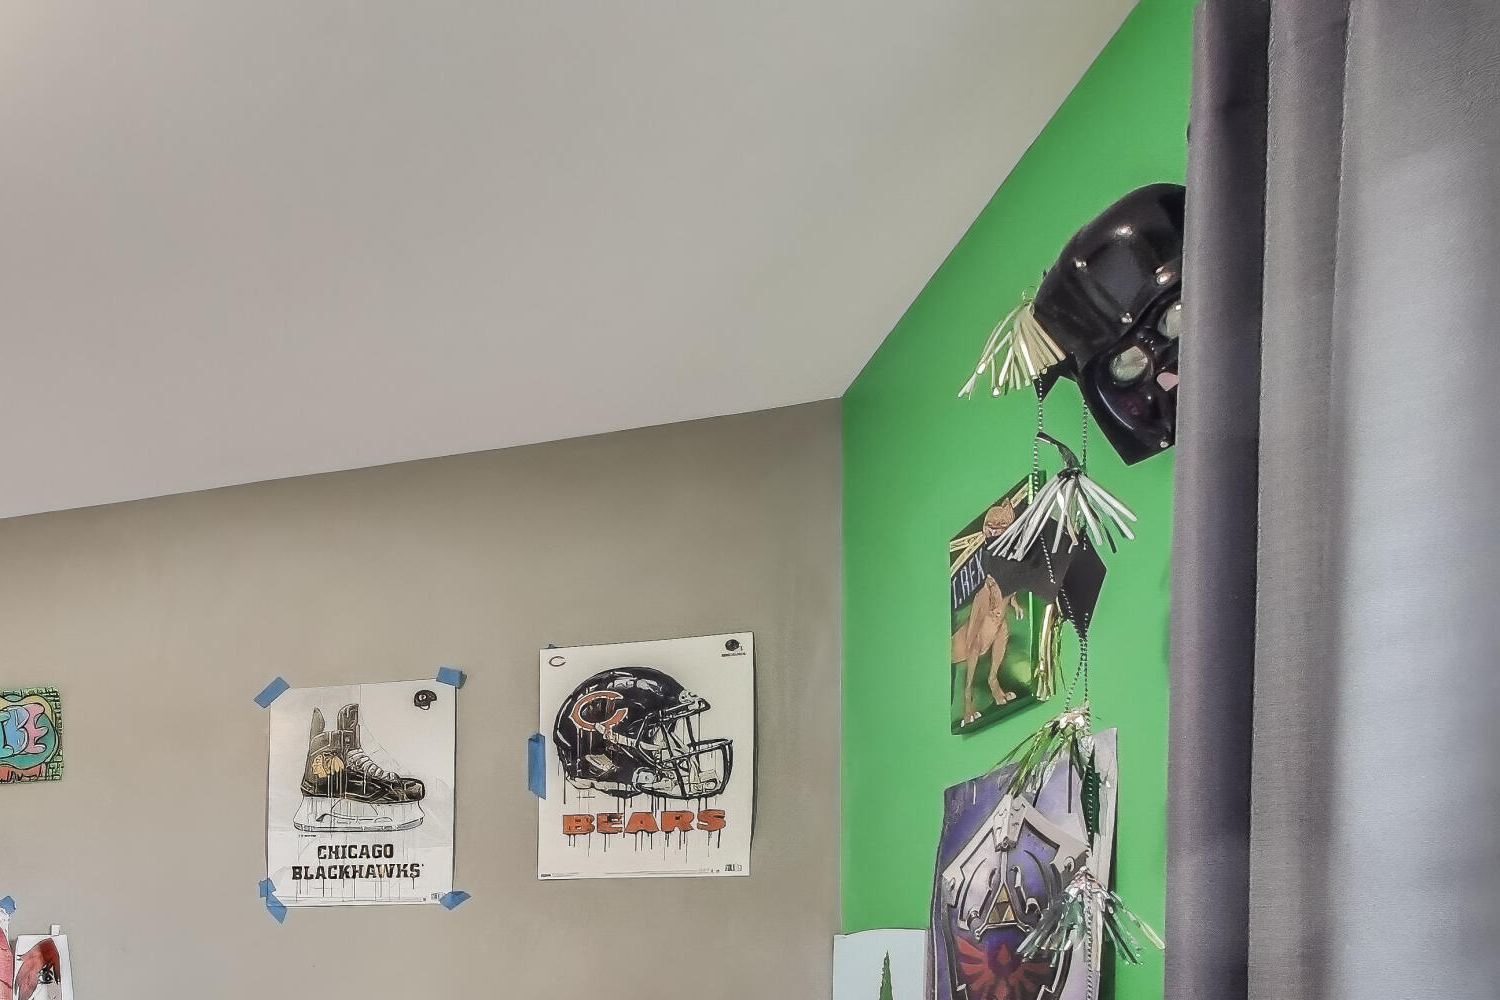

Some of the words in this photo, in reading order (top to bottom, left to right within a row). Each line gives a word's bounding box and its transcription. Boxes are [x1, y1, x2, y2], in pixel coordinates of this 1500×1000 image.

[562, 808, 727, 835] BEARS
[317, 843, 394, 860] CHICAGO
[291, 863, 421, 880] BLACKHAWKS
